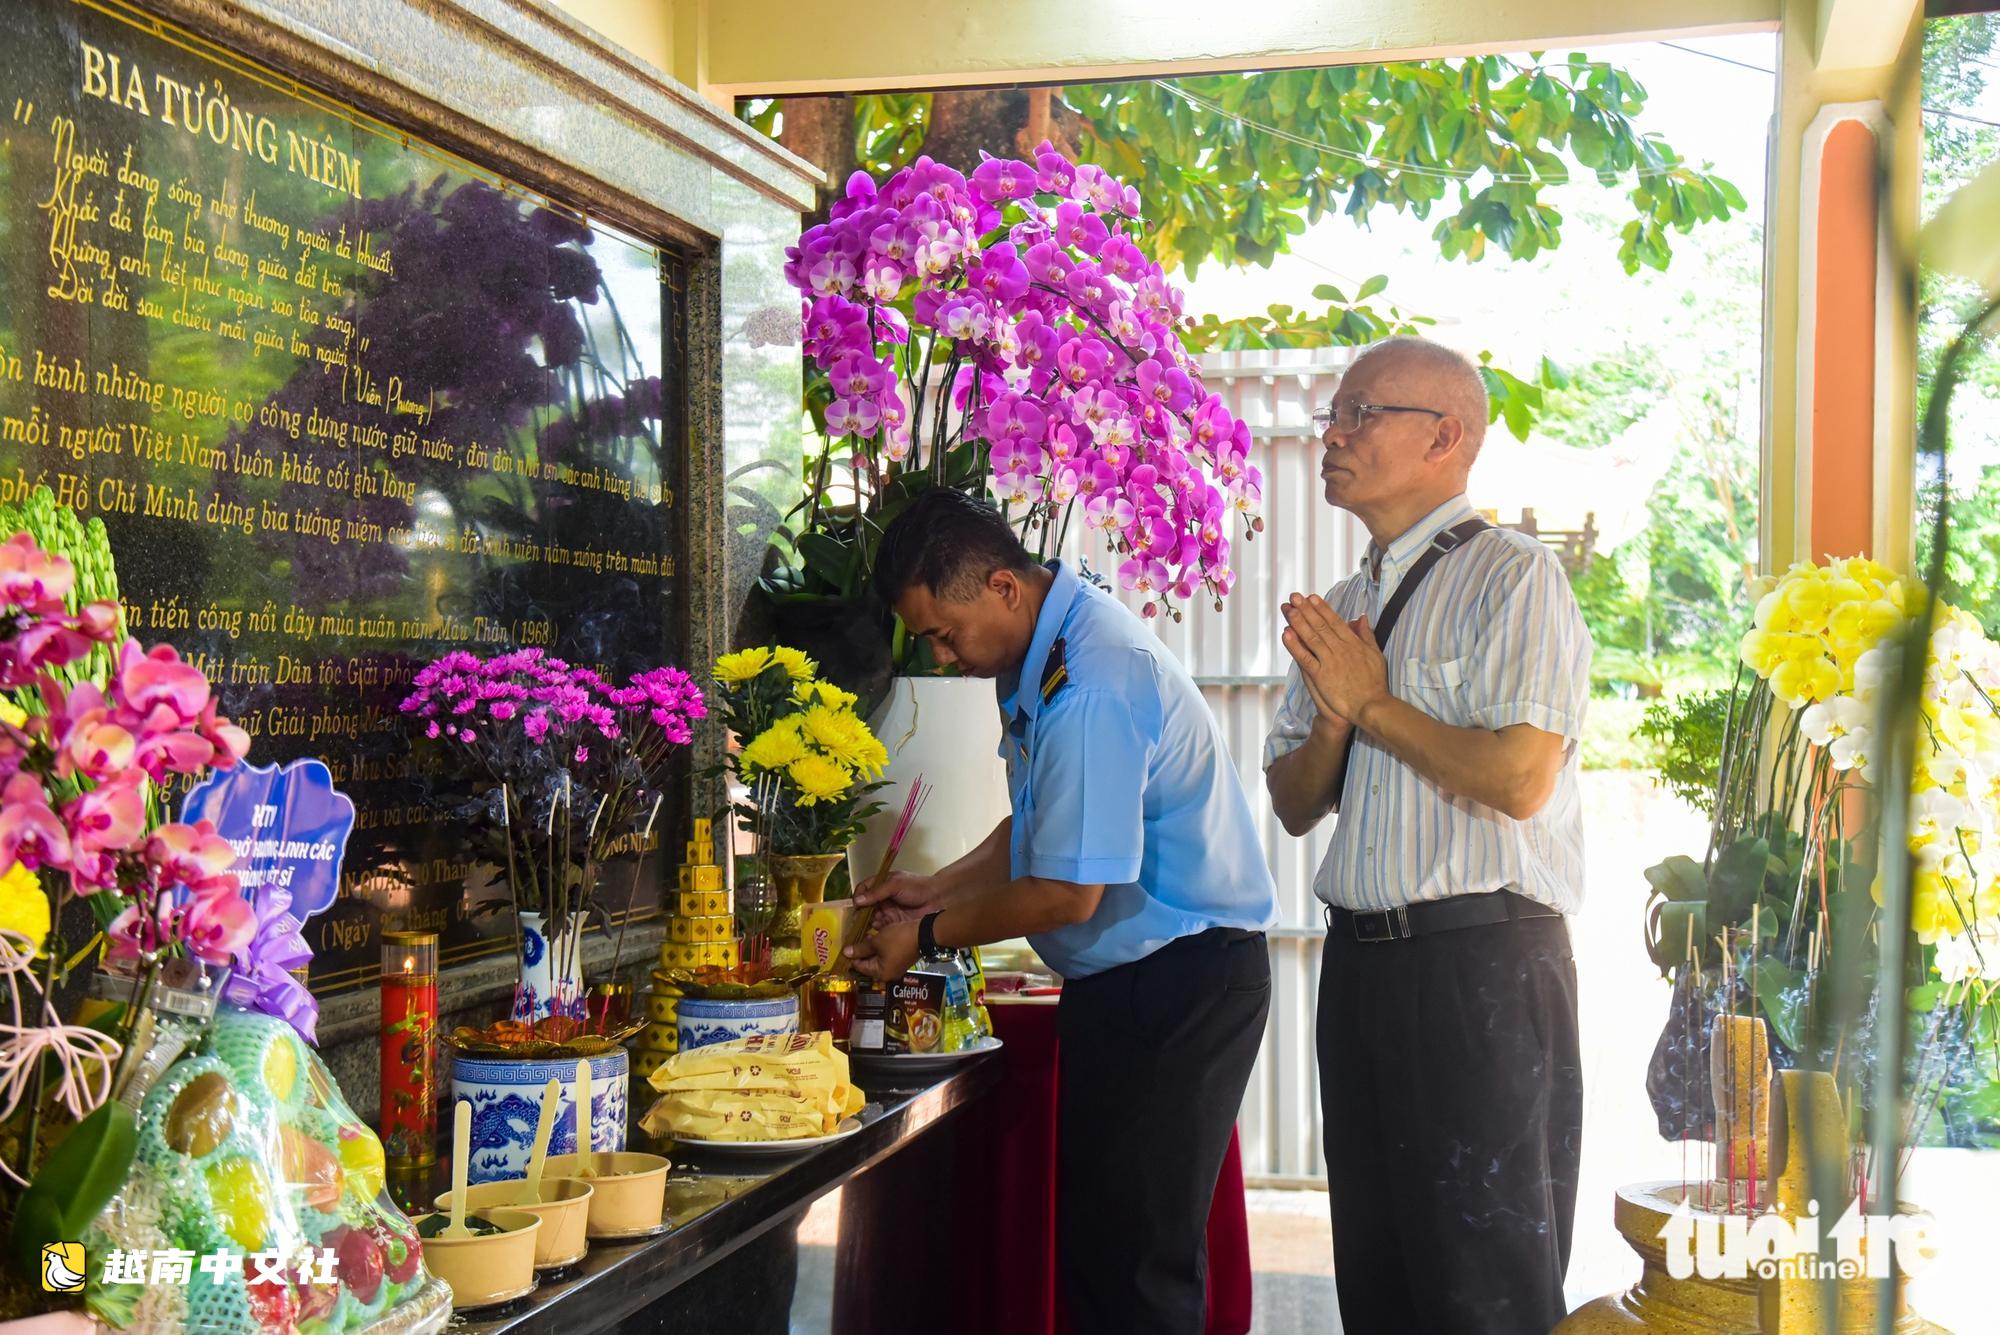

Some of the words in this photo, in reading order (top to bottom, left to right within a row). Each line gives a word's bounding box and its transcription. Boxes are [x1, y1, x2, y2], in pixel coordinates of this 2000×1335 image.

[80, 40, 150, 116] BIA
[156, 74, 279, 166] TƯỞNG
[287, 130, 362, 200] NIỆM
[51, 115, 110, 184] Người
[118, 144, 160, 205] đang
[168, 177, 202, 220] sống
[244, 188, 290, 250] thương
[184, 212, 205, 255] bia
[120, 237, 151, 277] anh
[193, 256, 221, 297] như
[271, 300, 293, 316] sao
[137, 297, 164, 319] sau
[290, 329, 310, 358] tim
[34, 350, 88, 394] kính
[96, 362, 165, 413] những
[172, 386, 229, 420] người
[260, 400, 301, 439] công
[307, 407, 348, 448] dựng
[353, 424, 387, 449] nước
[392, 425, 418, 458] giữ
[3, 406, 50, 446] mỗi
[130, 423, 173, 468] Việt
[180, 433, 228, 471] Nam
[234, 443, 273, 478] luôn
[281, 452, 320, 486] khắc
[327, 460, 350, 490] cốt
[353, 466, 377, 498] ghi
[382, 469, 416, 506] lòng
[55, 473, 89, 511] Hồ
[99, 478, 136, 514] Chí
[144, 484, 200, 521] Minh
[206, 493, 256, 534] dựng
[261, 499, 289, 531] bia
[295, 507, 341, 544] tưởng
[346, 515, 383, 547] niệm
[605, 550, 629, 573] trên
[151, 595, 190, 629] tiến
[198, 603, 242, 639] công
[249, 600, 277, 632] nổi
[284, 605, 316, 641] dậy
[320, 610, 355, 637] mùa
[358, 614, 397, 638] xuân
[473, 616, 508, 643] Thân
[275, 655, 312, 686] Dân
[268, 706, 305, 736] Giải
[311, 705, 359, 741] phóng
[278, 840, 310, 860] LINH
[309, 839, 336, 862] CÁC
[892, 983, 929, 1001] CaféPHỐ
